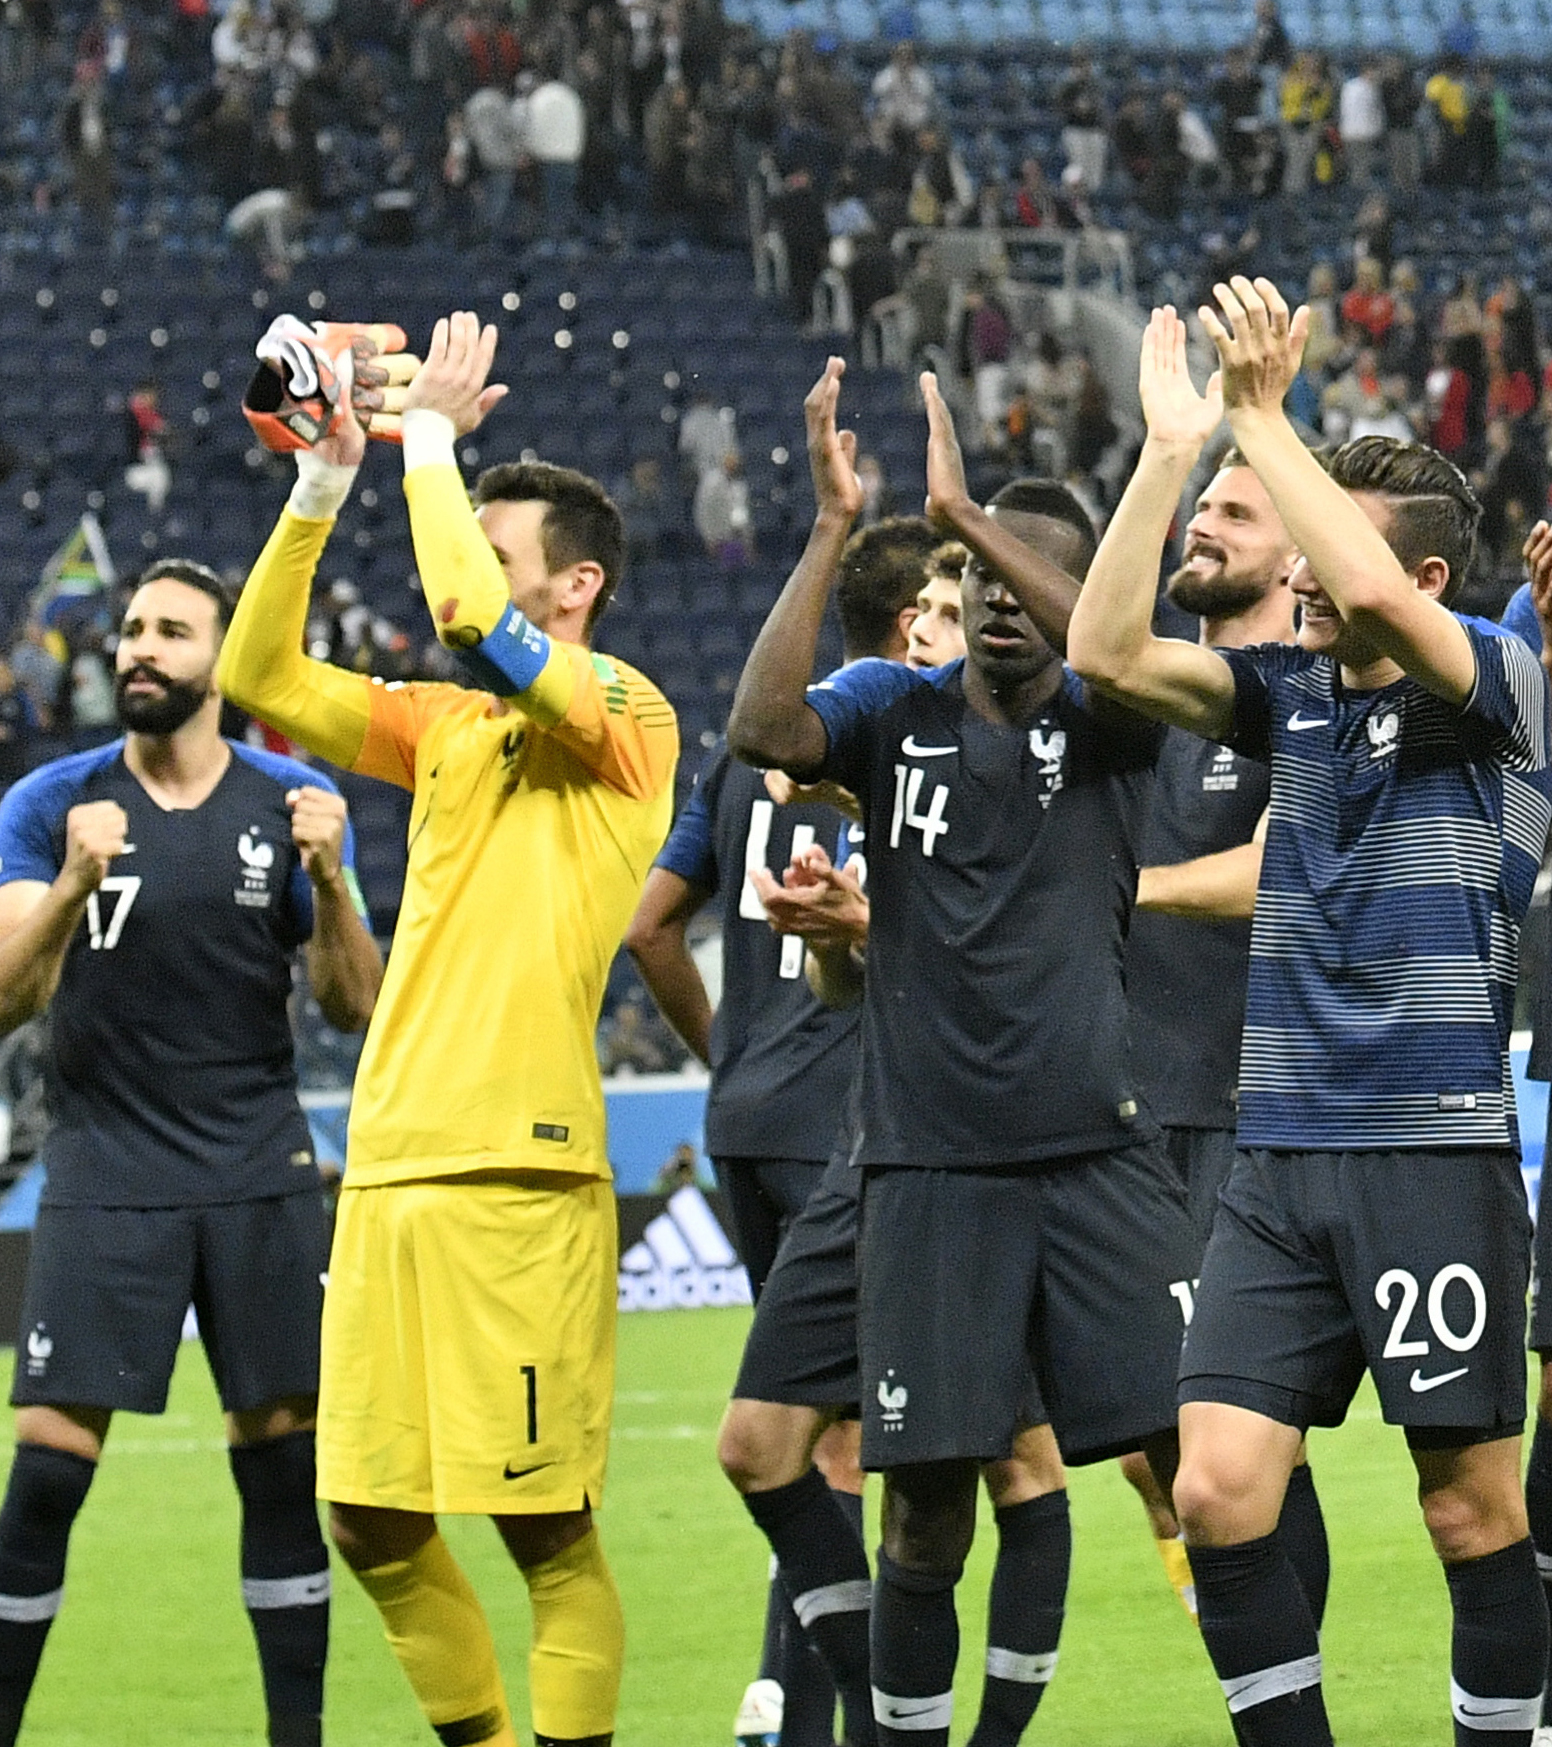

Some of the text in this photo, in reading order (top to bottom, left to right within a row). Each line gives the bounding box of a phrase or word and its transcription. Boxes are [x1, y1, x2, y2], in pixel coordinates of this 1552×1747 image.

[889, 763, 950, 858] 14
[86, 875, 142, 950] 17
[1168, 1278, 1200, 1326] 1
[1374, 1263, 1487, 1359] 20
[519, 1365, 538, 1444] 1
